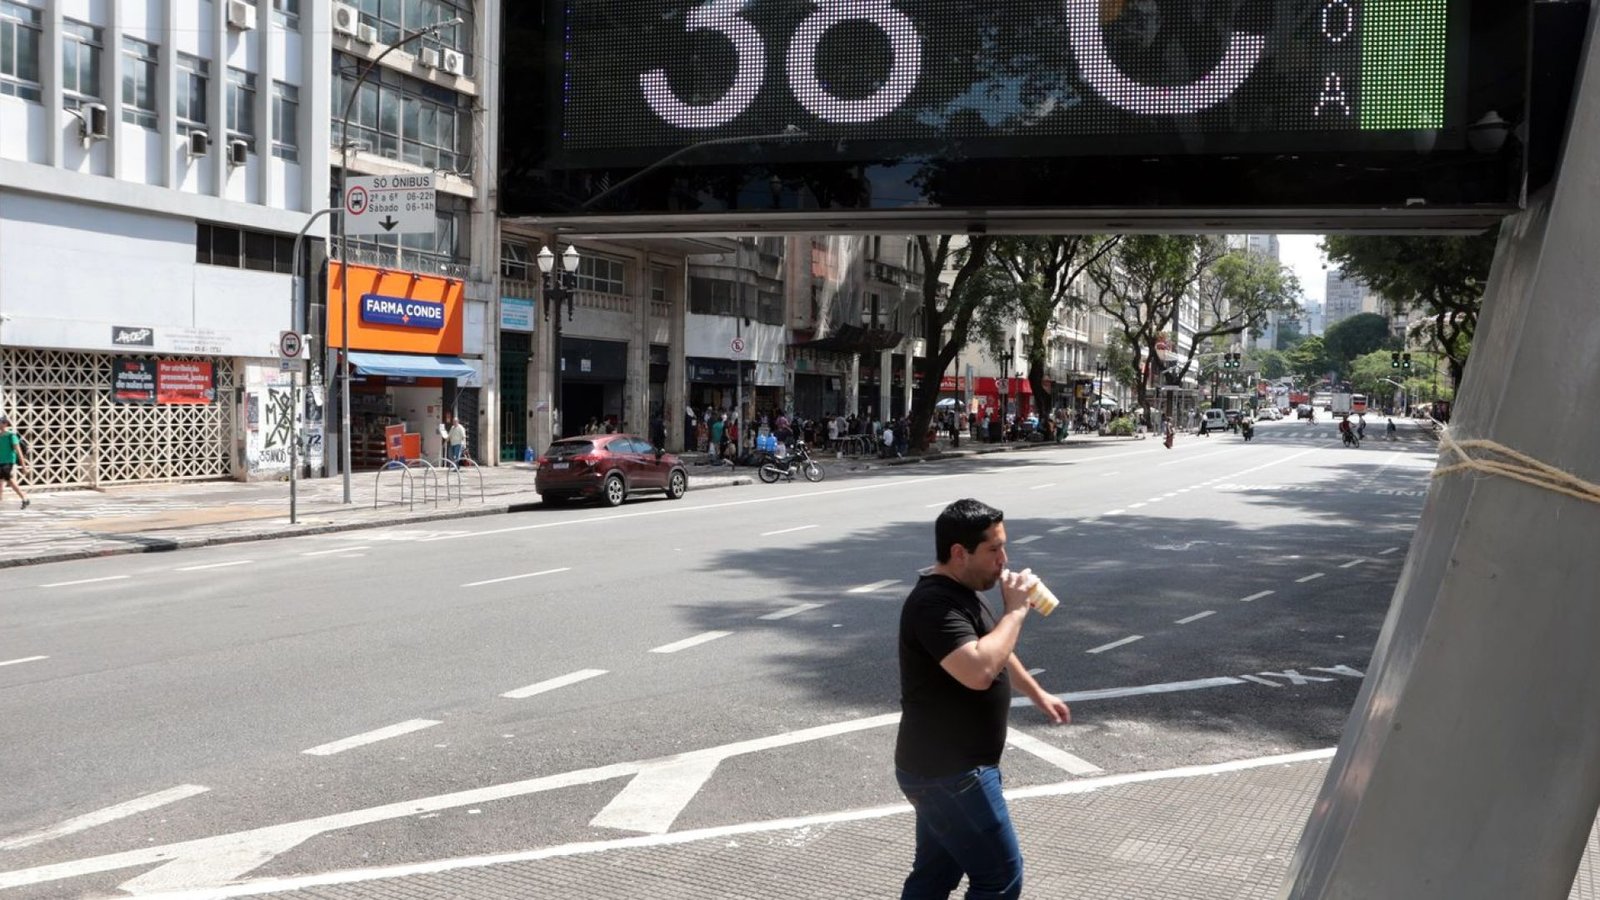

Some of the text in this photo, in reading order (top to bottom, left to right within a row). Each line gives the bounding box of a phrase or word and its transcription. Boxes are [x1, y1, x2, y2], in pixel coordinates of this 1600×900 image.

[392, 175, 430, 188] ÔNIBUS
[366, 298, 442, 319] FARMA CONDE
